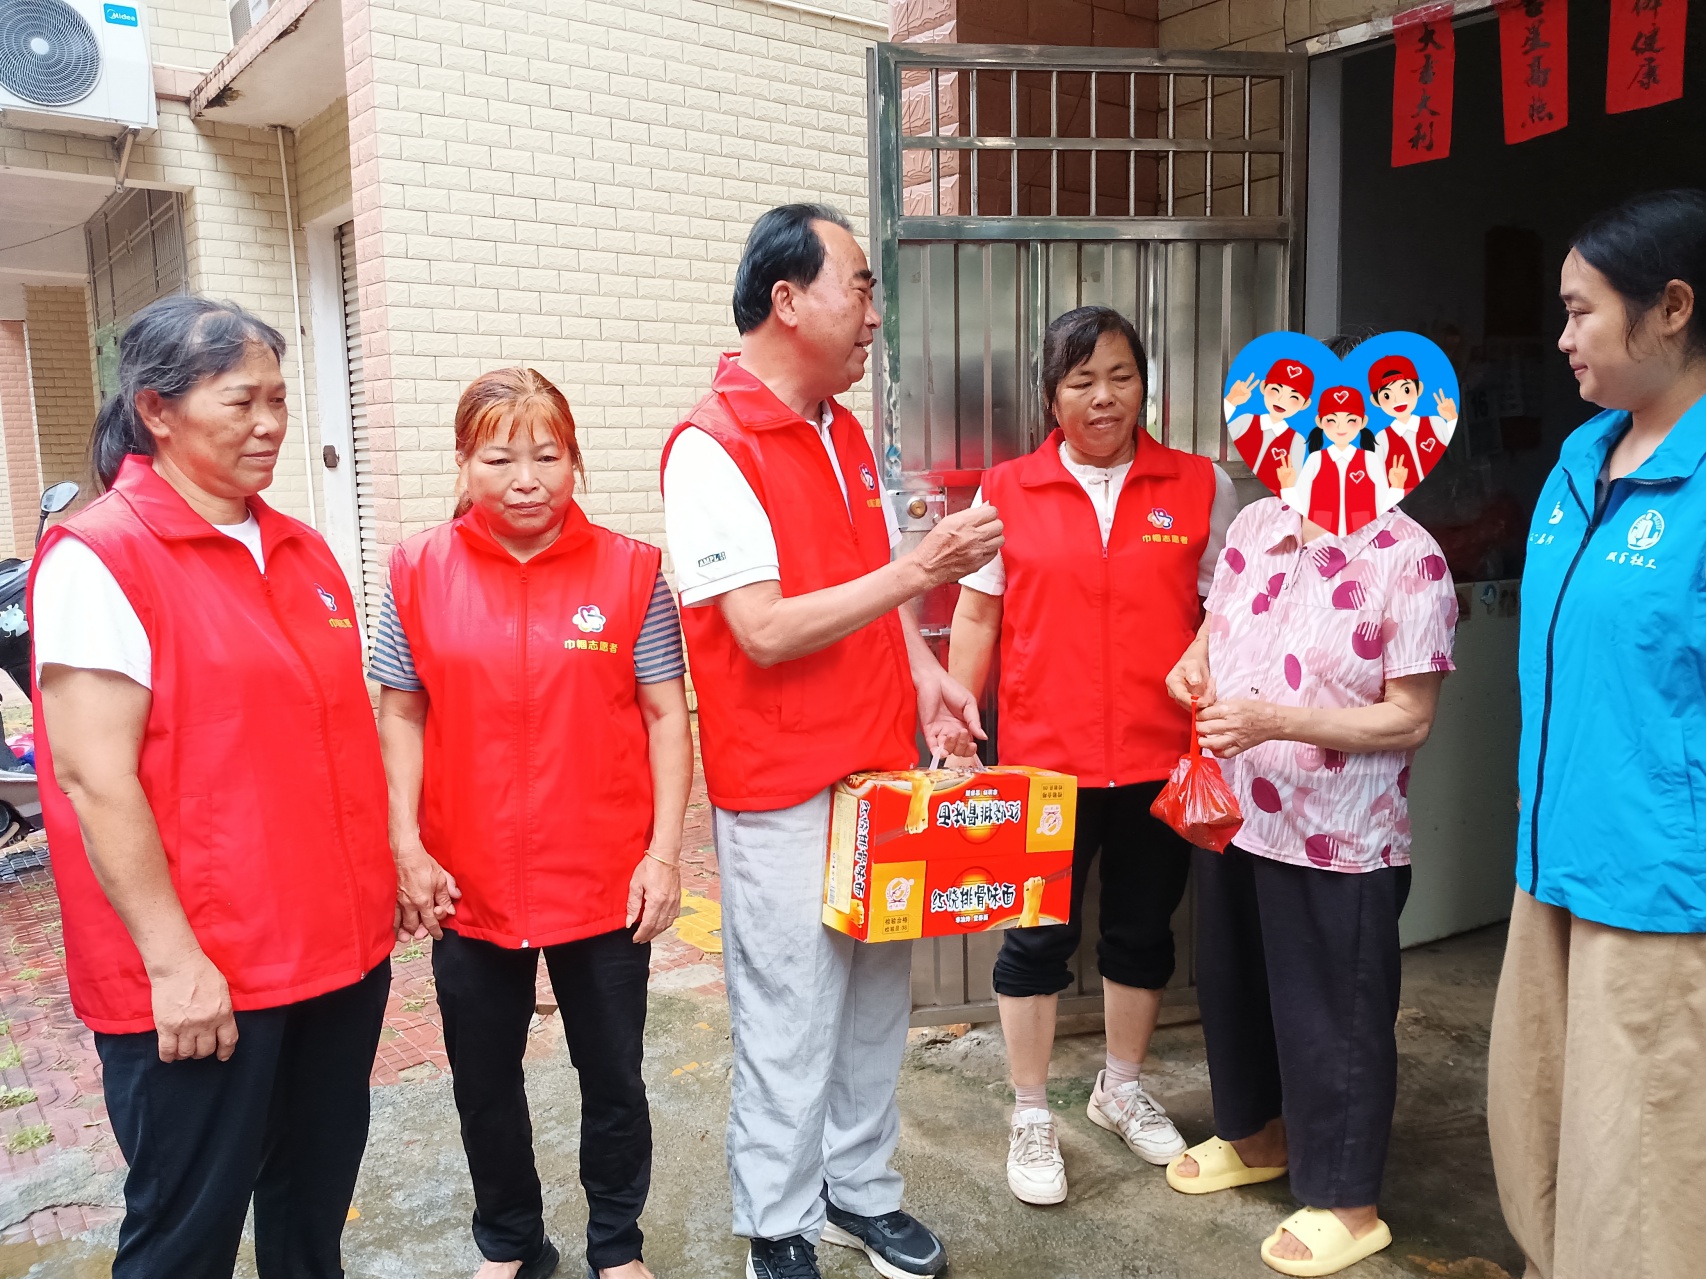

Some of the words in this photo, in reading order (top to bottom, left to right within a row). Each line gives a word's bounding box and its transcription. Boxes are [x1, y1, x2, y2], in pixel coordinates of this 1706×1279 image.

[109, 10, 136, 22] Midea
[1407, 20, 1446, 152] 大吉大利
[564, 639, 618, 654] 巾帼志愿者
[936, 800, 1021, 828] 红烧排骨味面
[853, 799, 871, 899] 红烧排骨味面
[931, 882, 1016, 913] 红烧排骨味面
